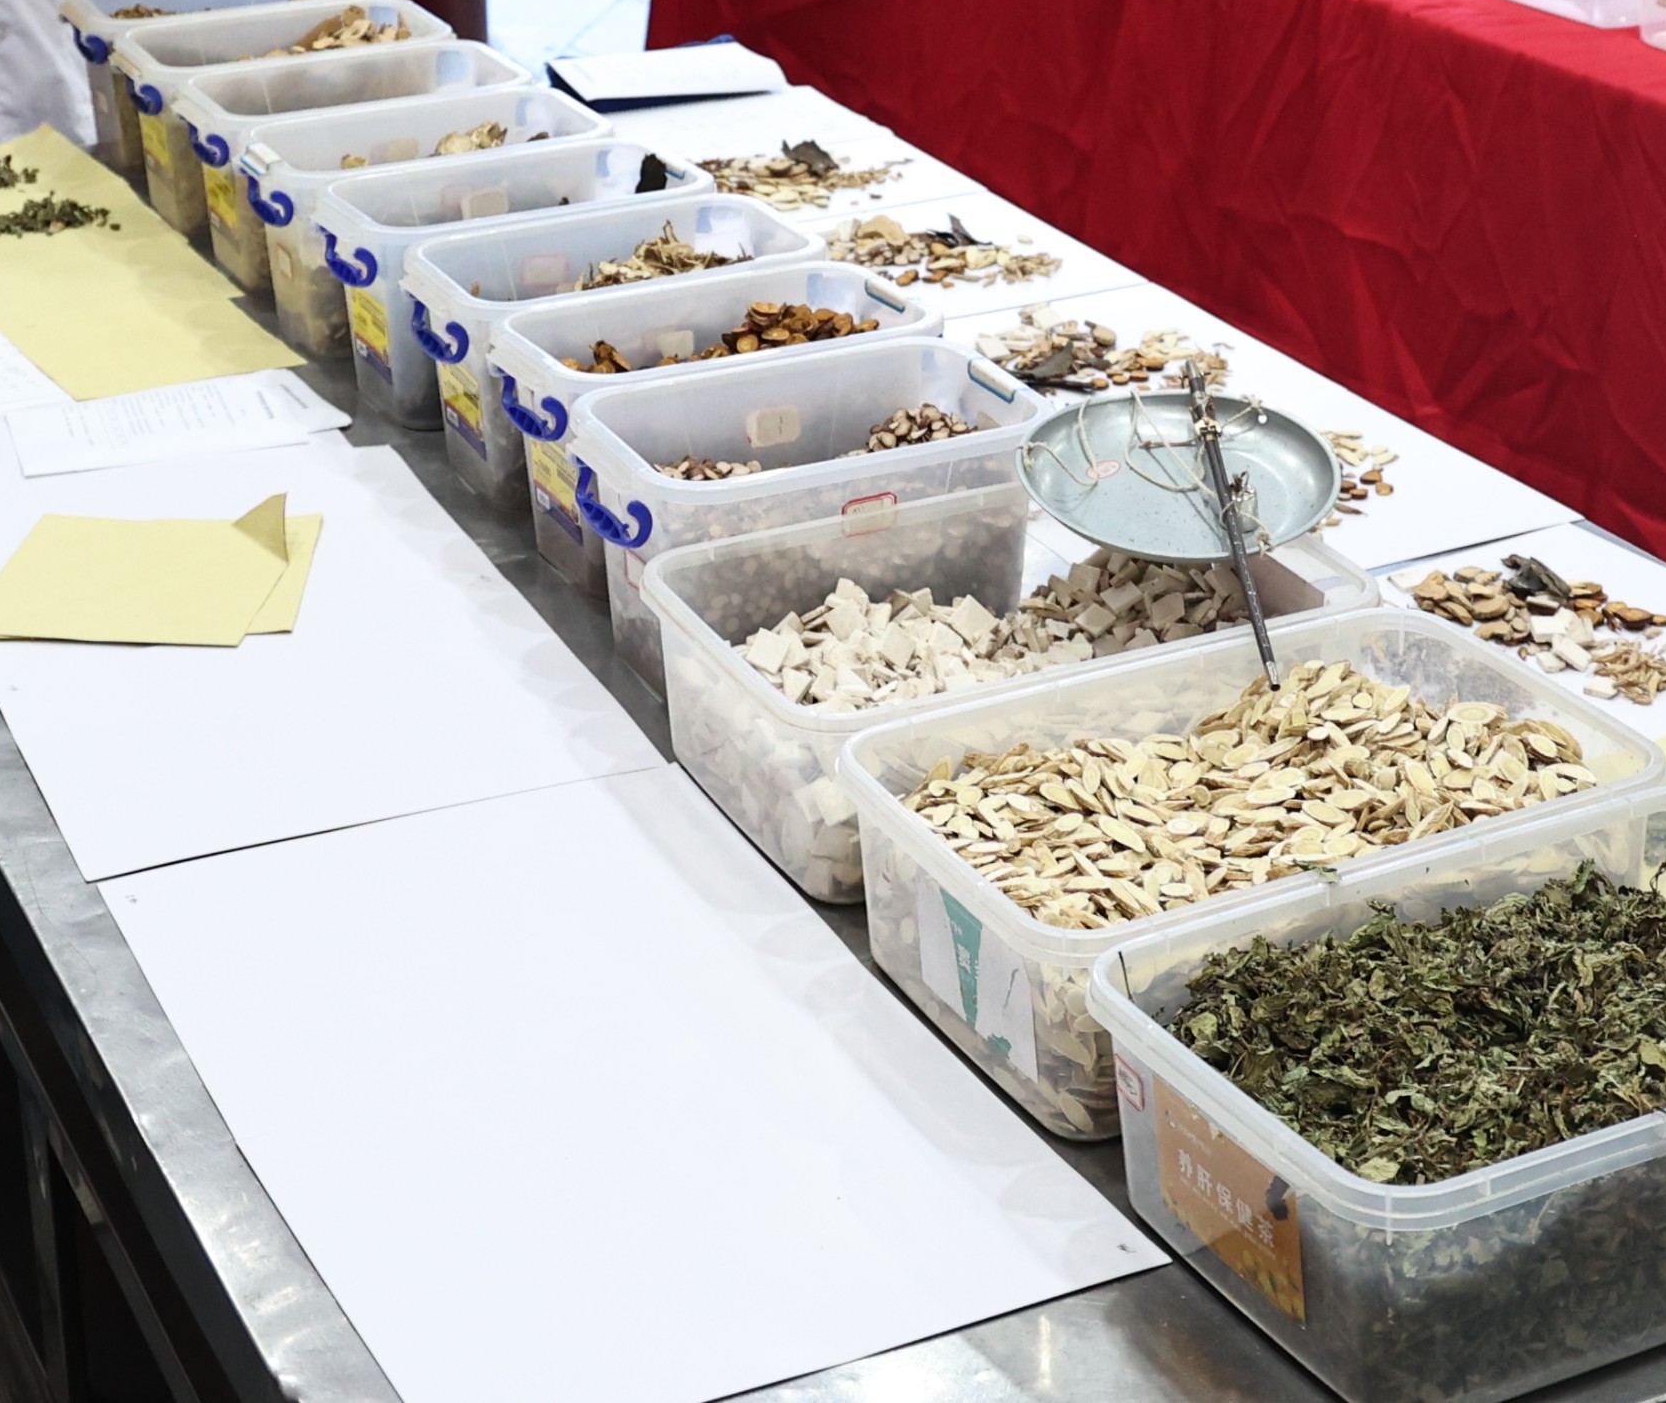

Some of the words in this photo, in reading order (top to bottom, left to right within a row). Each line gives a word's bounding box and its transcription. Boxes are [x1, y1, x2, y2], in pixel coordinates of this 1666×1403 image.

[1177, 1147, 1275, 1248] 养肝保健茶
